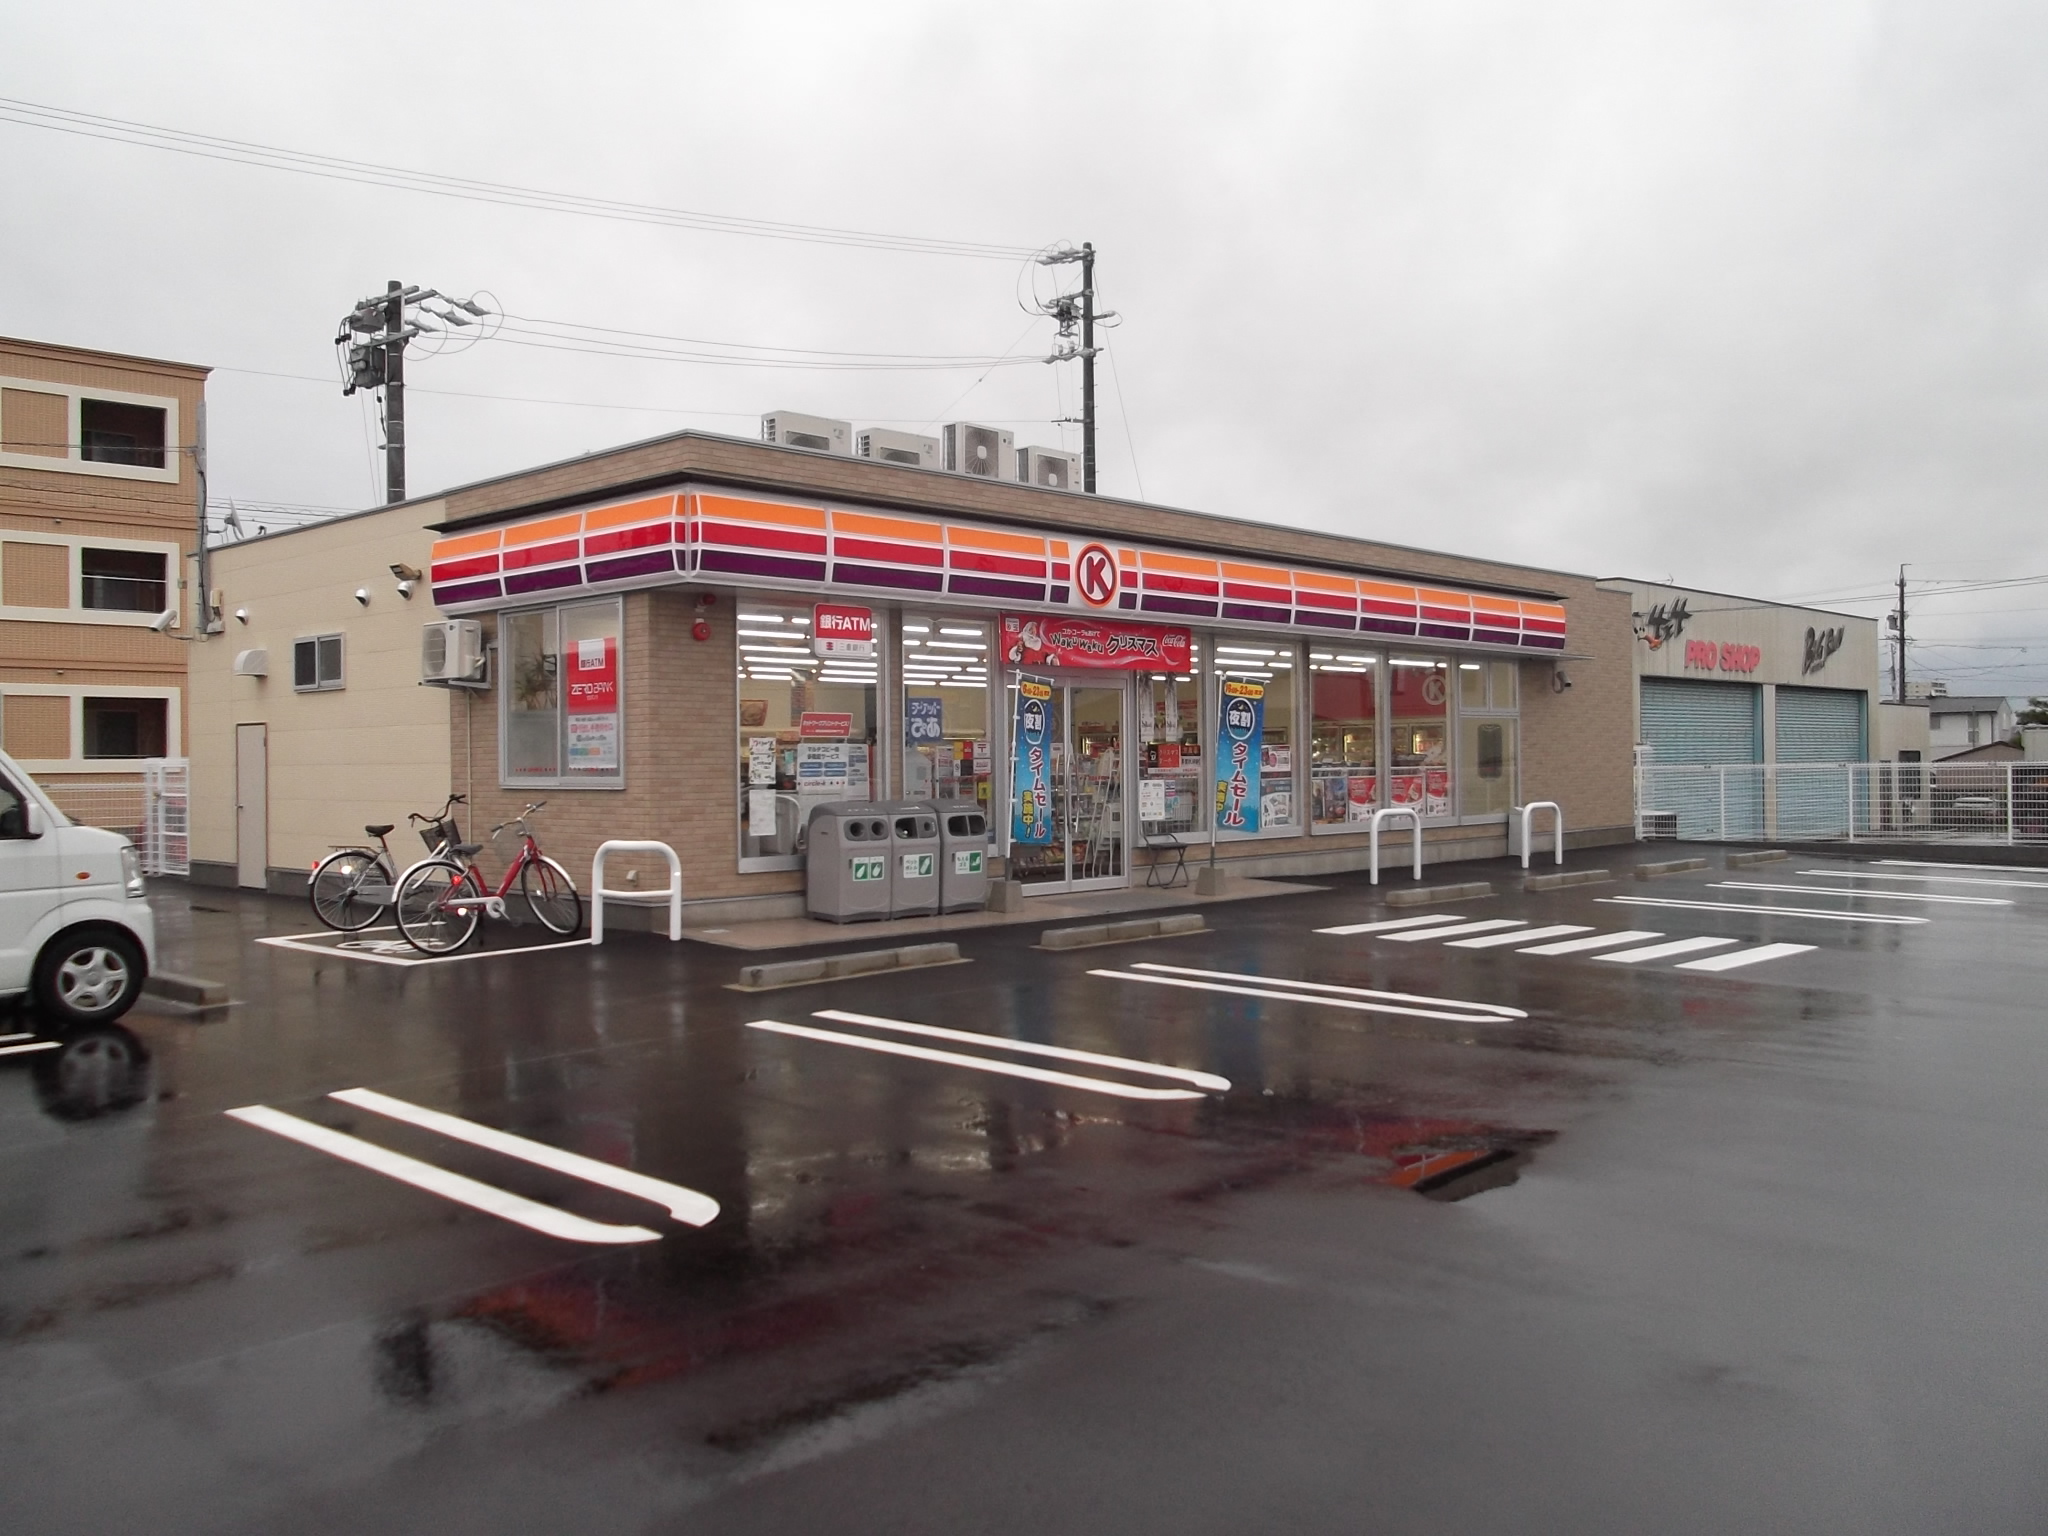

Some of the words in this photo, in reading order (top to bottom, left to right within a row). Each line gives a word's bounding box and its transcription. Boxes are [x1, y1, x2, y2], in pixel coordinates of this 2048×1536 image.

[819, 614, 870, 632] 銀行ATM
[1049, 632, 1078, 650] Waku
[1079, 639, 1104, 655] Waku
[1106, 635, 1159, 657] クリスマス
[1685, 640, 1718, 671] PRO
[1719, 642, 1761, 673] SHOP
[571, 684, 593, 695] ZERO
[911, 717, 940, 738] ぴあ
[1025, 711, 1043, 731] 夜割
[1229, 710, 1251, 728] 夜割
[1029, 747, 1047, 839] タイムセール
[1223, 742, 1247, 826] タイムセール
